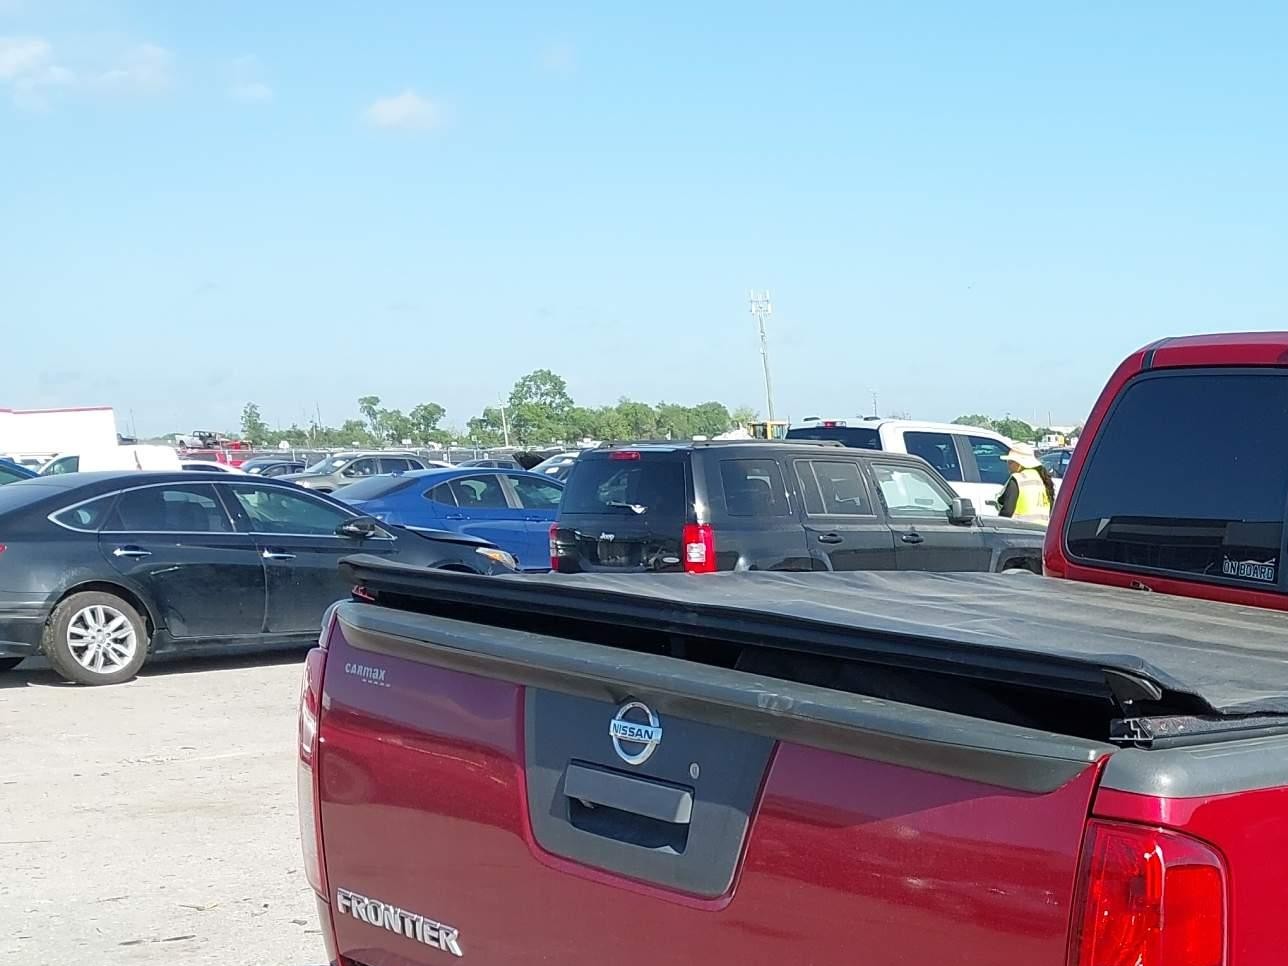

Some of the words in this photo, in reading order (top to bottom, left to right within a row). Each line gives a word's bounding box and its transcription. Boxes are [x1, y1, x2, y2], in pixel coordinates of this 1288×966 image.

[1223, 560, 1239, 575] ON
[1239, 563, 1275, 581] BOARD
[612, 722, 654, 740] NISSAN
[337, 887, 463, 957] FRONTIER
